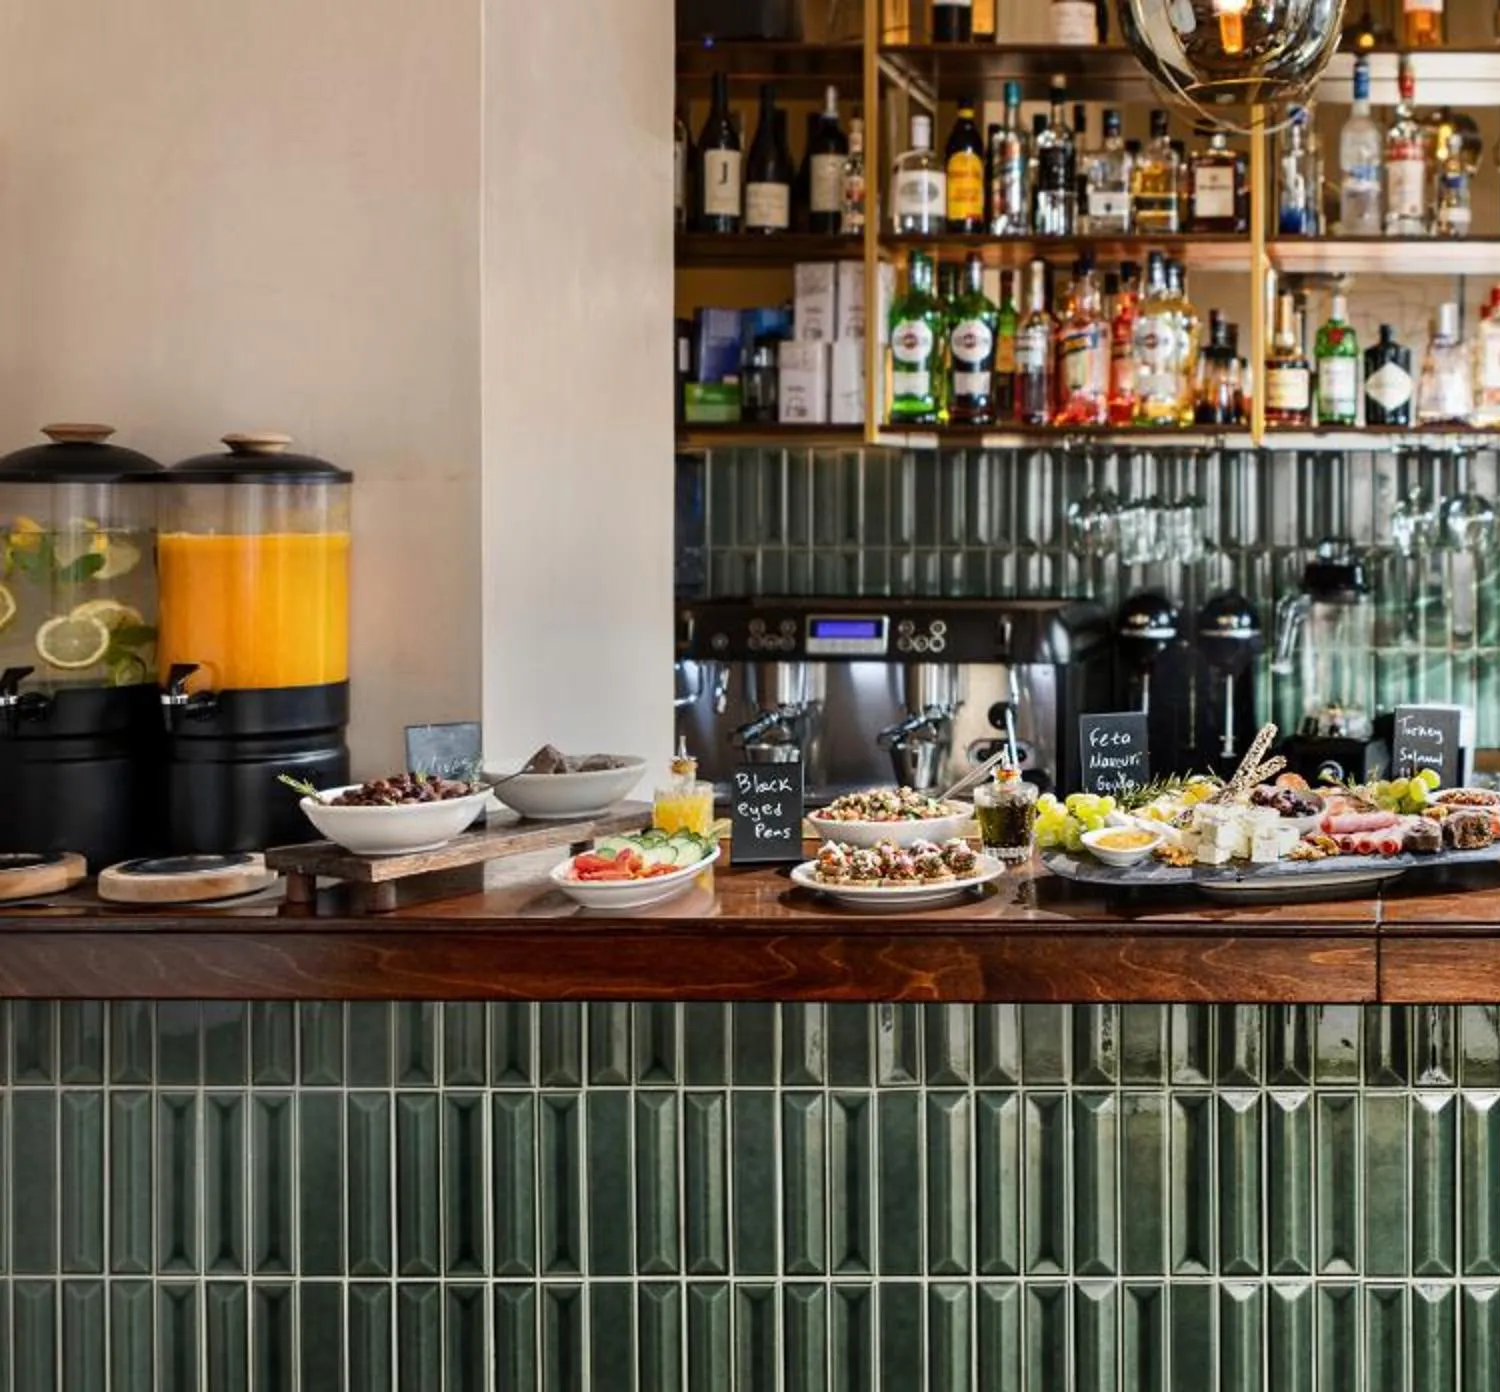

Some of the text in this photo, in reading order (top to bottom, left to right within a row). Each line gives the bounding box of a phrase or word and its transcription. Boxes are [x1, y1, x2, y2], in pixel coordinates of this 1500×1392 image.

[1089, 727, 1131, 748] Feta
[735, 772, 793, 795] Black
[737, 802, 783, 823] eyed
